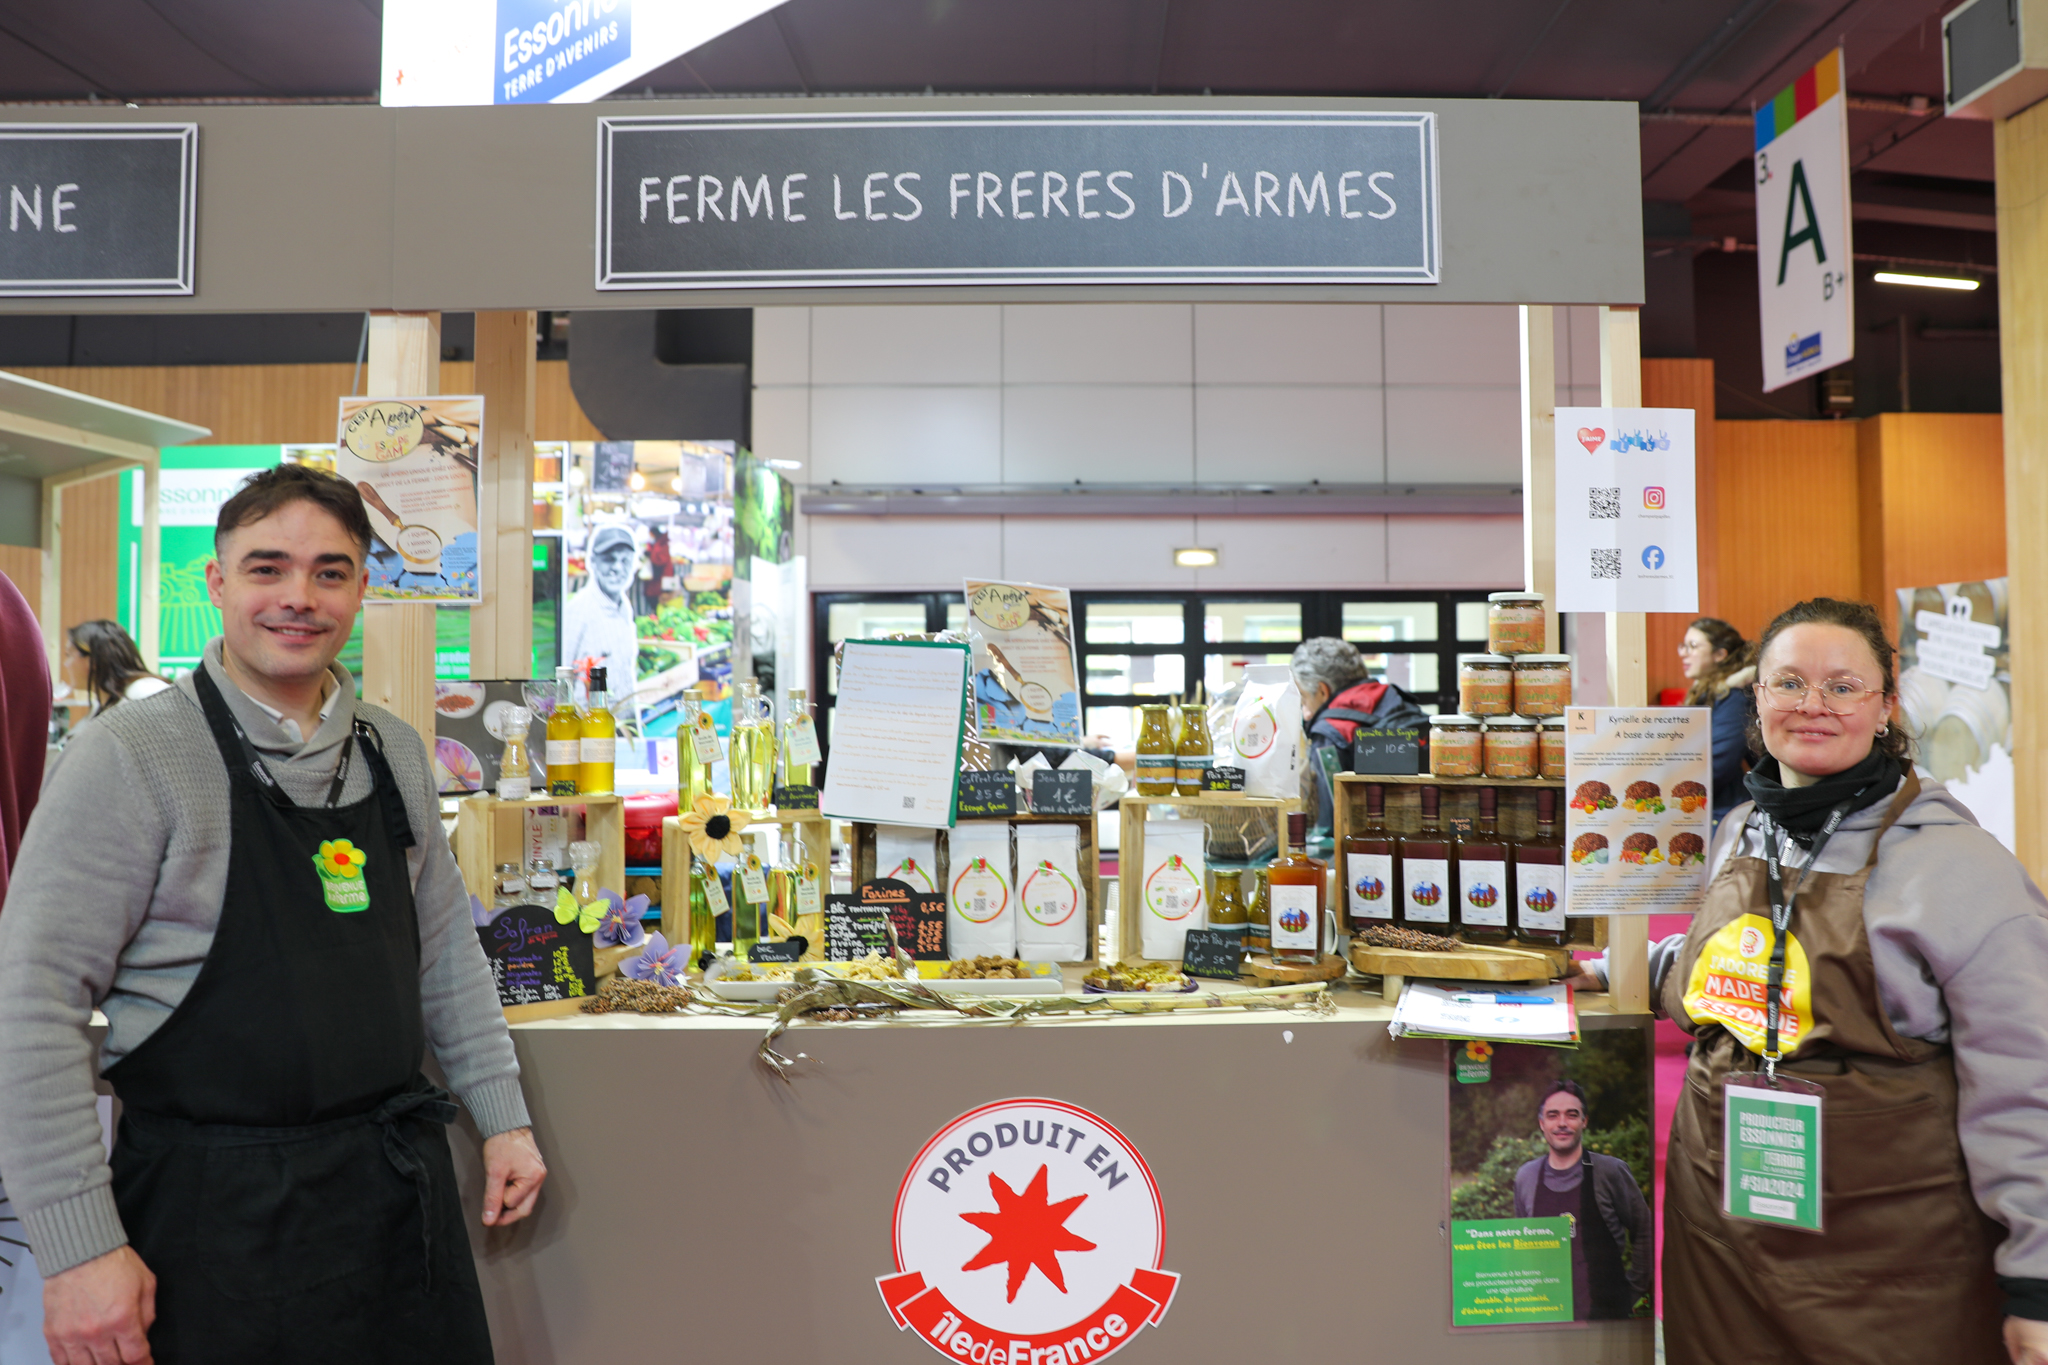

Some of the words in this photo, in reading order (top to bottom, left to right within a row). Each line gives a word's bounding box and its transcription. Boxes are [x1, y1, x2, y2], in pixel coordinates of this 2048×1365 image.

[503, 63, 543, 101] TERRE
[546, 20, 618, 78] D'AVENIRS
[639, 173, 808, 224] FERME
[833, 172, 923, 222] LES
[949, 170, 1136, 220] FRERES
[1162, 163, 1397, 220] D'ARMES
[9, 183, 80, 233] NE
[1777, 158, 1827, 287] A
[1609, 714, 1640, 725] Kyrielle
[1642, 715, 1653, 724] de
[1654, 715, 1690, 724] recettes
[1623, 731, 1643, 739] base
[1644, 731, 1655, 739] de
[1657, 731, 1685, 741] sorgho
[862, 885, 906, 899] Farines
[494, 916, 554, 953] Safran
[1709, 955, 1770, 981] J'ADORE
[1705, 975, 1766, 1003] MADE
[1694, 997, 1799, 1034] ESSONE
[1739, 1111, 1805, 1134] PRODUCTEUR
[1739, 1126, 1806, 1150] ESSONNIEN
[927, 1119, 1086, 1193] PRODUIT
[1083, 1144, 1129, 1190] EN
[1764, 1150, 1806, 1170] TERROIR
[1740, 1174, 1806, 1200] #SIA2024
[1496, 1227, 1521, 1237] notre
[1523, 1226, 1555, 1237] ferme,
[1498, 1239, 1512, 1249] les
